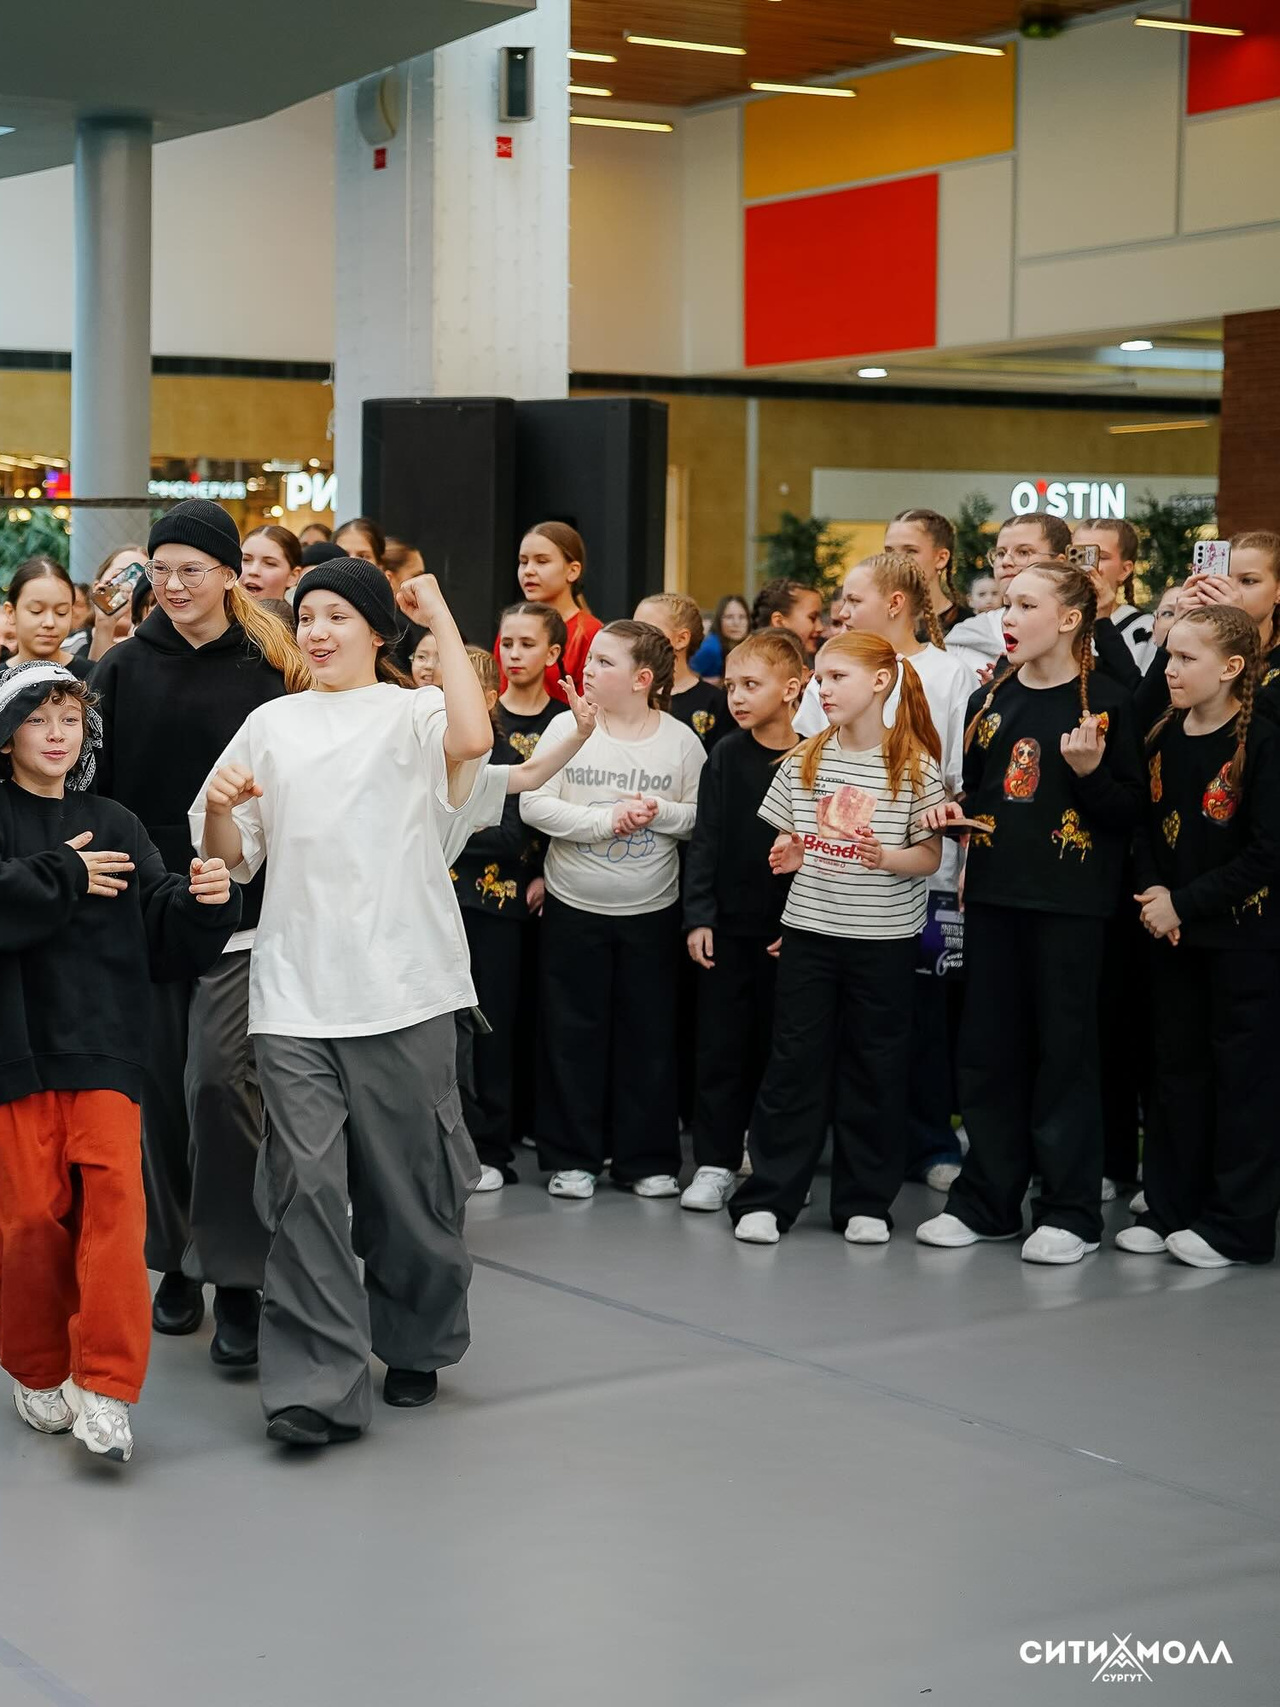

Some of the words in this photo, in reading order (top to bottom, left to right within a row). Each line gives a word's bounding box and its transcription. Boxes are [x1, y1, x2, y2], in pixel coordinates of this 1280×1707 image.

[1010, 479, 1126, 519] O'STIN
[565, 765, 637, 791] natural
[637, 769, 672, 792] boo
